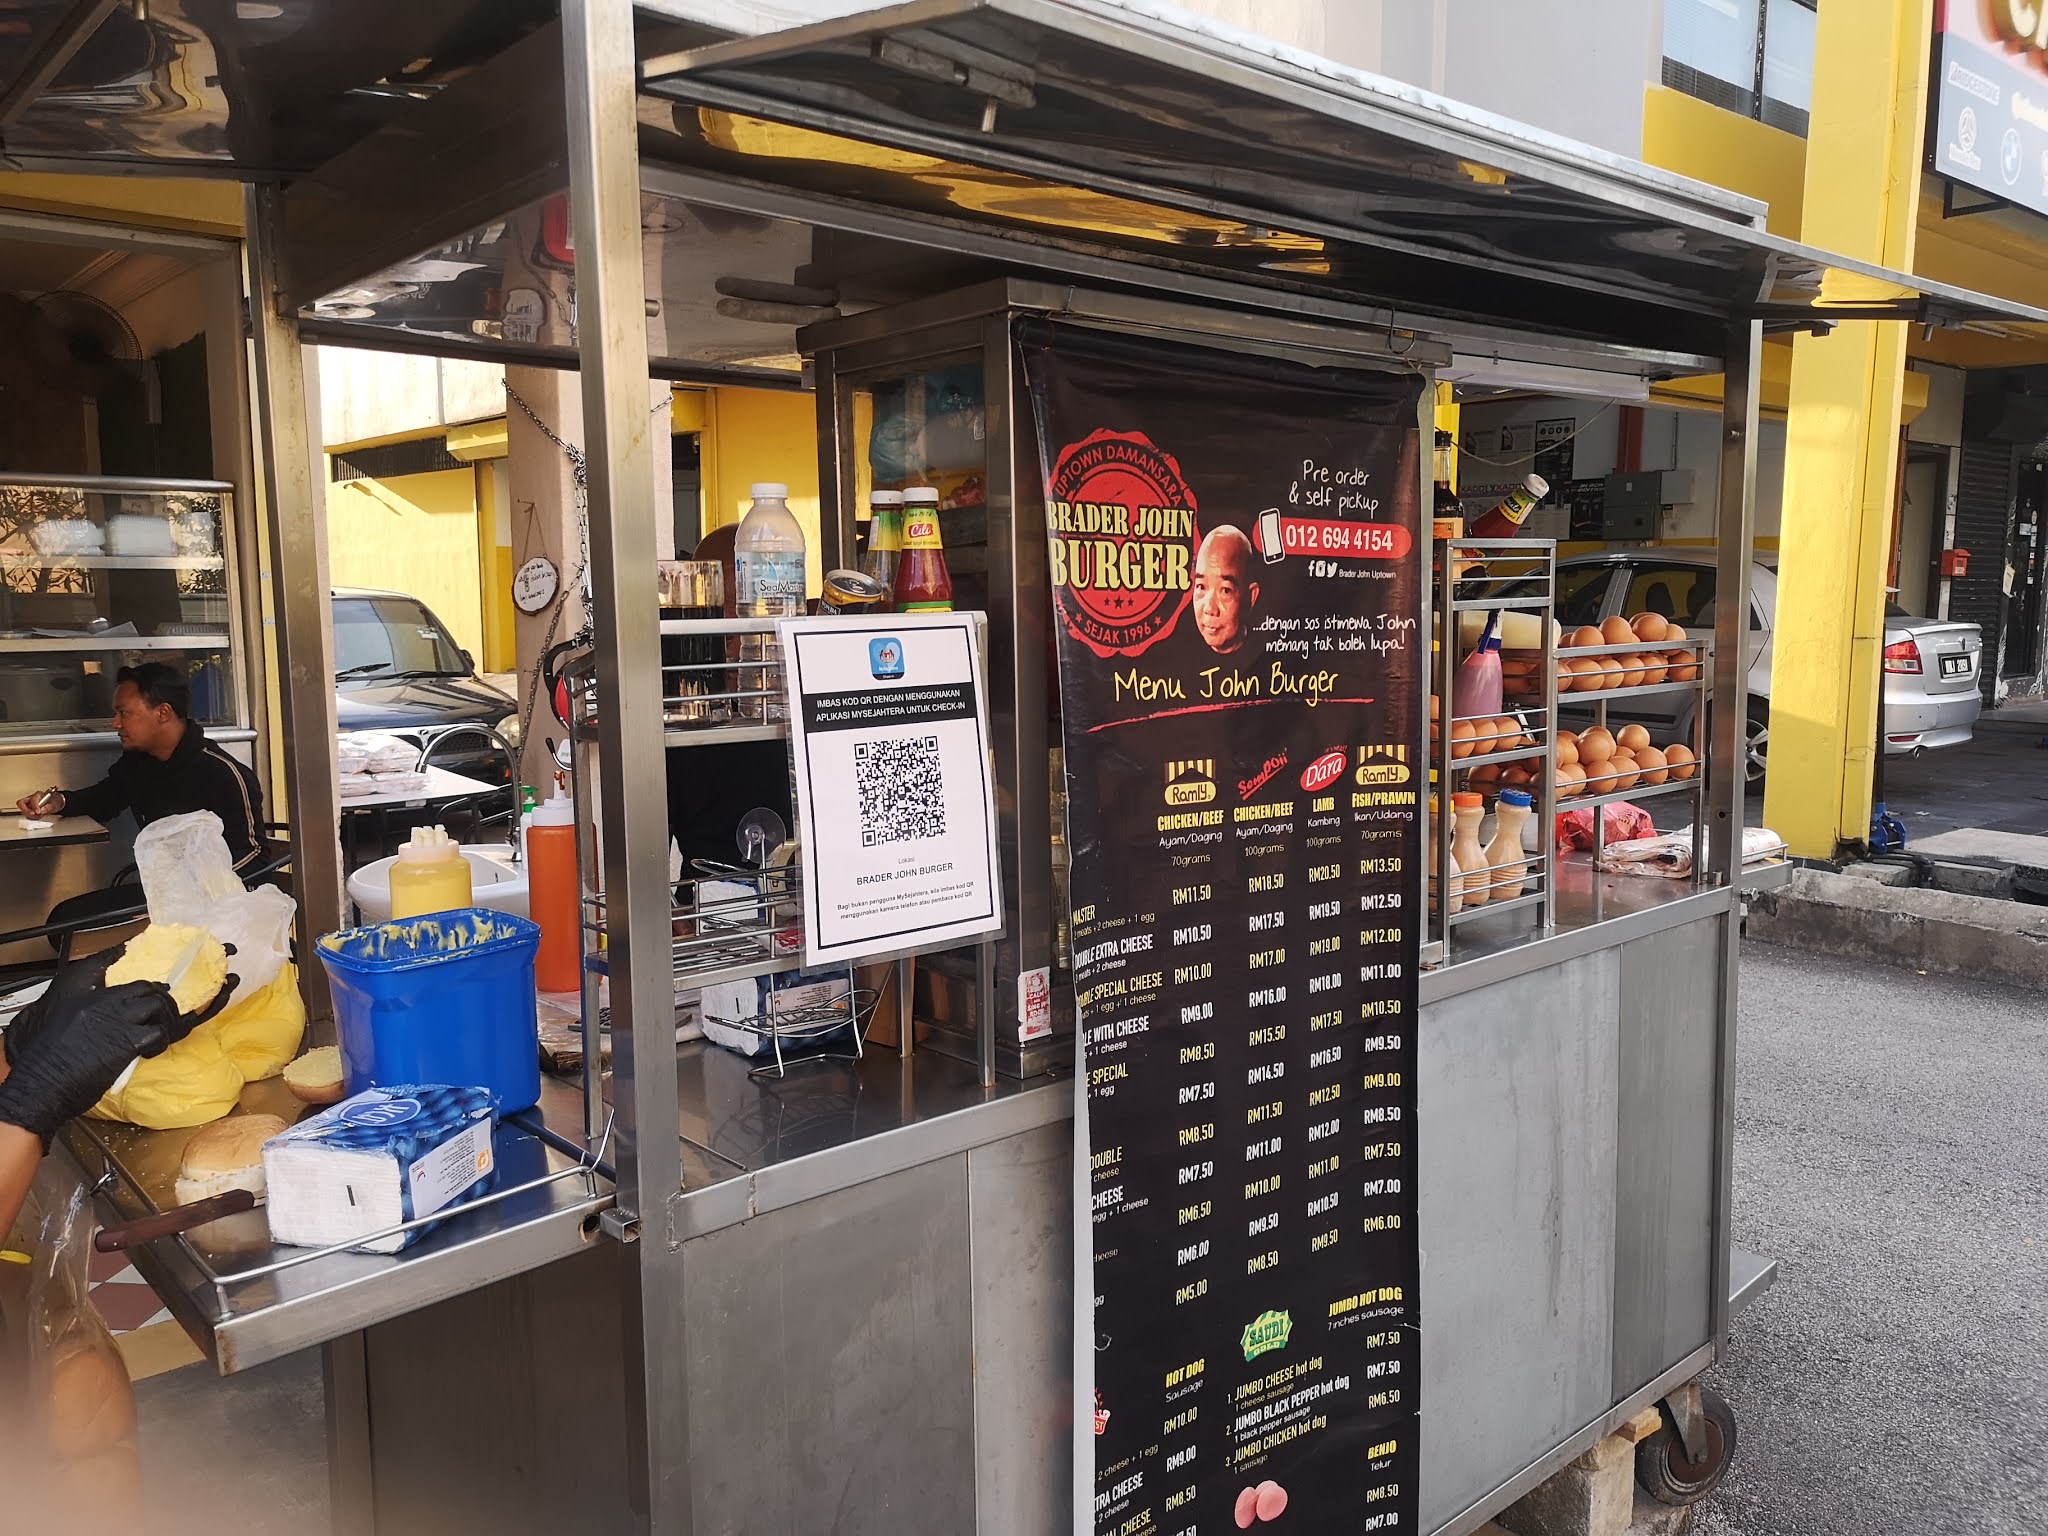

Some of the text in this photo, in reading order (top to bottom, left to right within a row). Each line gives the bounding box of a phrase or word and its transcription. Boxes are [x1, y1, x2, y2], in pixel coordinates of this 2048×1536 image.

[1055, 444, 1183, 507] UPTOWN DAMANSARA
[1303, 460, 1371, 487] Pre order
[1288, 481, 1380, 519] & self pickup
[1047, 500, 1194, 538] BRADER JOHN
[911, 524, 931, 537] Cili
[1285, 524, 1393, 551] 012 694 4154
[1050, 538, 1191, 591] BURGER
[1338, 568, 1397, 581] Brader John Uptown
[1084, 621, 1152, 645] SEJAK 1996
[1304, 617, 1320, 631] sos
[1376, 614, 1417, 630] John
[1265, 634, 1406, 659] memang tak boleh lupa!
[1114, 661, 1339, 707] Menu John Burger
[816, 689, 960, 709] IMBAS KOD QR DENGAN MENGGUNAKAN
[816, 701, 965, 722] APLIKASI MYSEJAHTERA UNTUK CHECK-IN
[1305, 757, 1342, 788] Dara
[1362, 767, 1398, 783] Ramly
[1172, 784, 1207, 803] Ramly
[1352, 792, 1416, 808] FISH/PRAWN
[1233, 801, 1294, 822] CHICKEN/BEEF
[1312, 797, 1335, 813] LAMB
[1354, 809, 1413, 822] Ikan/Udang
[1157, 809, 1224, 832] CHICKEN/BEEF
[1235, 822, 1294, 839] Ayam/Daging
[1307, 816, 1341, 828] Kambing
[1159, 831, 1223, 849] Ayam/Daging
[1306, 836, 1342, 848] 100grams
[1361, 829, 1402, 841] 70grams
[1172, 853, 1211, 867] 70grams
[1245, 843, 1285, 857] 100grams
[856, 862, 953, 886] BRADER JOHN BURGER
[1308, 864, 1341, 883] RM20.50
[1360, 858, 1402, 875] RM13.50
[1248, 873, 1284, 893] RM18.50
[1173, 885, 1211, 905] RM11.50
[1361, 894, 1402, 911] RM12.50
[1073, 904, 1096, 927] MASTER
[1309, 900, 1341, 920] RM19.50
[1249, 912, 1284, 932] RM17.50
[1173, 924, 1212, 946] RM10.50
[1360, 928, 1401, 945] RM12.00
[1074, 934, 1153, 970] DOUBLE EXTRA CHEESE
[1309, 936, 1341, 956] RM19.00
[1249, 949, 1286, 969] RM17.00
[1175, 963, 1212, 985] RM10.00
[1361, 964, 1401, 981] RM11.00
[1094, 979, 1128, 1000] SPECIAL
[1130, 971, 1163, 992] CHEESE
[1249, 986, 1287, 1008] RM16.00
[1181, 1002, 1213, 1025] RM9.00
[1361, 1000, 1401, 1018] RM10.50
[1180, 1043, 1215, 1064] RM8.50
[1365, 1036, 1401, 1052] RM9.50
[1092, 1062, 1128, 1085] SPECIAL
[1364, 1072, 1401, 1090] RM9.00
[1178, 1082, 1215, 1105] RM7.50
[1364, 1106, 1401, 1124] RM8.50
[1179, 1123, 1214, 1147] RM8.50
[1090, 1146, 1123, 1171] DOUBLE
[1364, 1142, 1401, 1160] RM7.50
[1178, 1161, 1214, 1185] RM7.50
[1091, 1185, 1124, 1211] CHEESE
[1364, 1179, 1401, 1196] RM7.00
[1178, 1201, 1212, 1226] RM6.50
[1364, 1215, 1401, 1234] RM6.00
[1178, 1240, 1210, 1266] RM6.00
[1176, 1278, 1208, 1306] RM5.00
[1328, 1286, 1403, 1318] JUMBO HOT DOG
[1333, 1314, 1360, 1329] inches
[1361, 1306, 1404, 1321] sausage
[1250, 1319, 1284, 1346] SAUDI
[1366, 1331, 1400, 1349] RM7.50
[1166, 1358, 1205, 1388] HOT DOG
[1235, 1380, 1263, 1401] JUMBO
[1265, 1367, 1294, 1388] CHEESE
[1295, 1362, 1307, 1378] hot
[1309, 1356, 1323, 1371] dog
[1367, 1360, 1400, 1379] RM7.50
[1165, 1379, 1203, 1402] Sausage
[1368, 1390, 1400, 1409] RM6.50
[1234, 1412, 1262, 1433] JUMBO
[1263, 1400, 1290, 1421] BLACK
[1291, 1386, 1320, 1408] PEPPER
[1321, 1381, 1333, 1395] hot
[1335, 1375, 1349, 1391] dog
[1164, 1406, 1198, 1435] RM10.00
[1233, 1443, 1261, 1464] JUMBO
[1263, 1425, 1297, 1450] CHICKEN
[1299, 1420, 1311, 1435] hot
[1312, 1414, 1327, 1429] dog
[1166, 1445, 1197, 1473] RM9.00
[1368, 1440, 1397, 1460] BENJO
[1370, 1459, 1393, 1471] Telur
[1165, 1484, 1196, 1512] RM8.50
[1366, 1484, 1399, 1503] RM8.50
[1365, 1512, 1398, 1532] RM7.00
